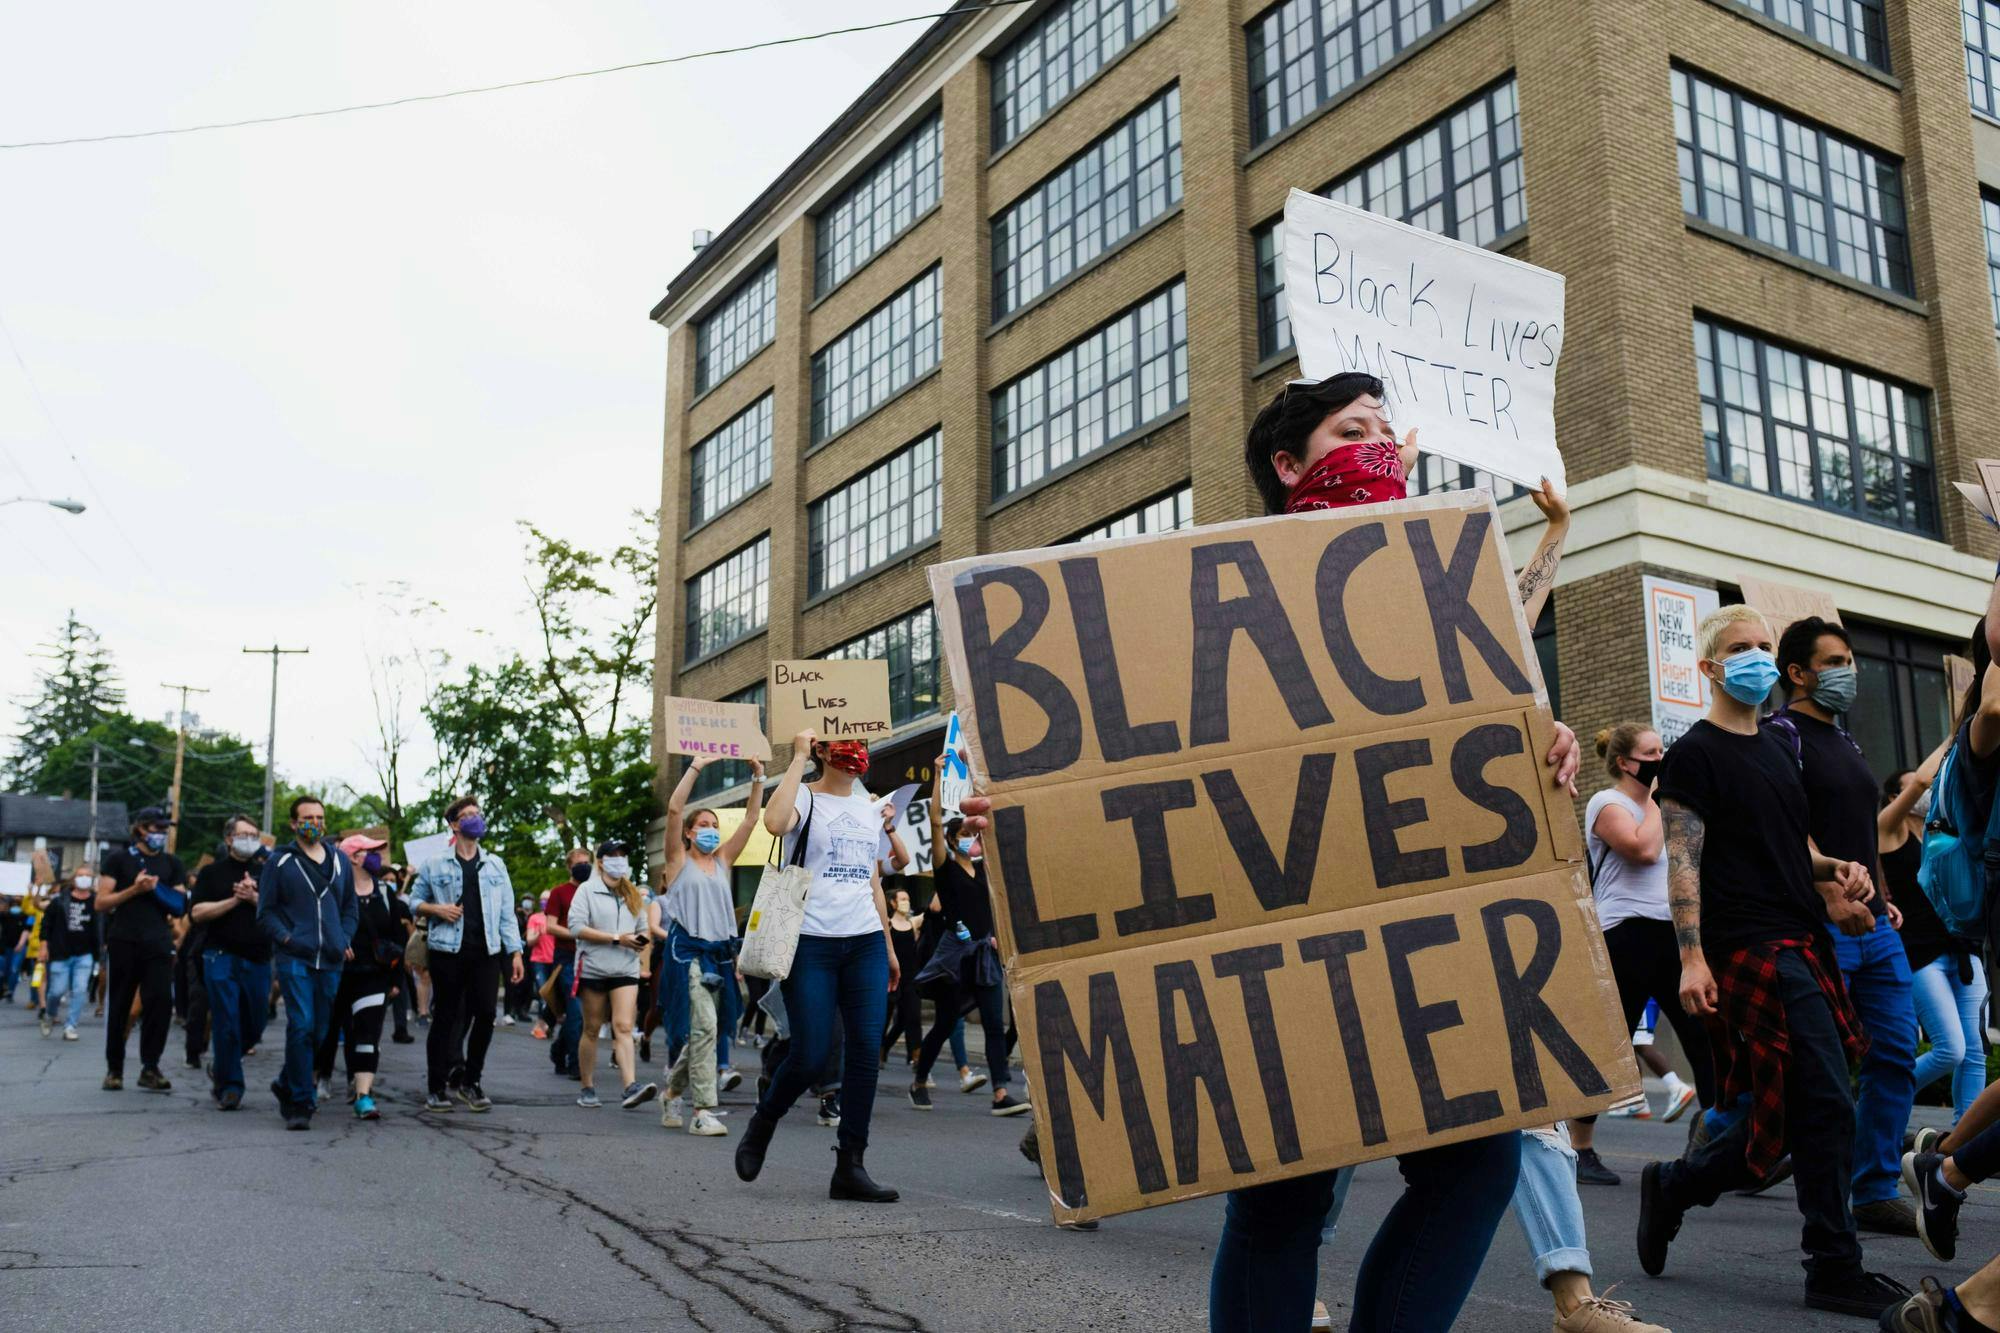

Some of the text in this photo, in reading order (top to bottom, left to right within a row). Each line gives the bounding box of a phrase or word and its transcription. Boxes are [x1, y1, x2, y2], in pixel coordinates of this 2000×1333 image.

[1314, 232, 1558, 369] Black Lives
[1333, 327, 1518, 440] MATTER
[1657, 595, 1686, 616] YOUR
[1659, 613, 1683, 630] NEW
[954, 512, 1534, 782] BLACK
[1660, 630, 1693, 650] OFFICE
[1661, 647, 1671, 662] IS
[776, 664, 824, 684] BLACK
[1662, 663, 1692, 682] RIGHT
[803, 689, 847, 710] LIVES
[678, 716, 738, 728] SILENCE
[824, 716, 889, 734] MATTER
[991, 723, 1538, 953] LIVES
[1034, 898, 1612, 1208] MATTER
